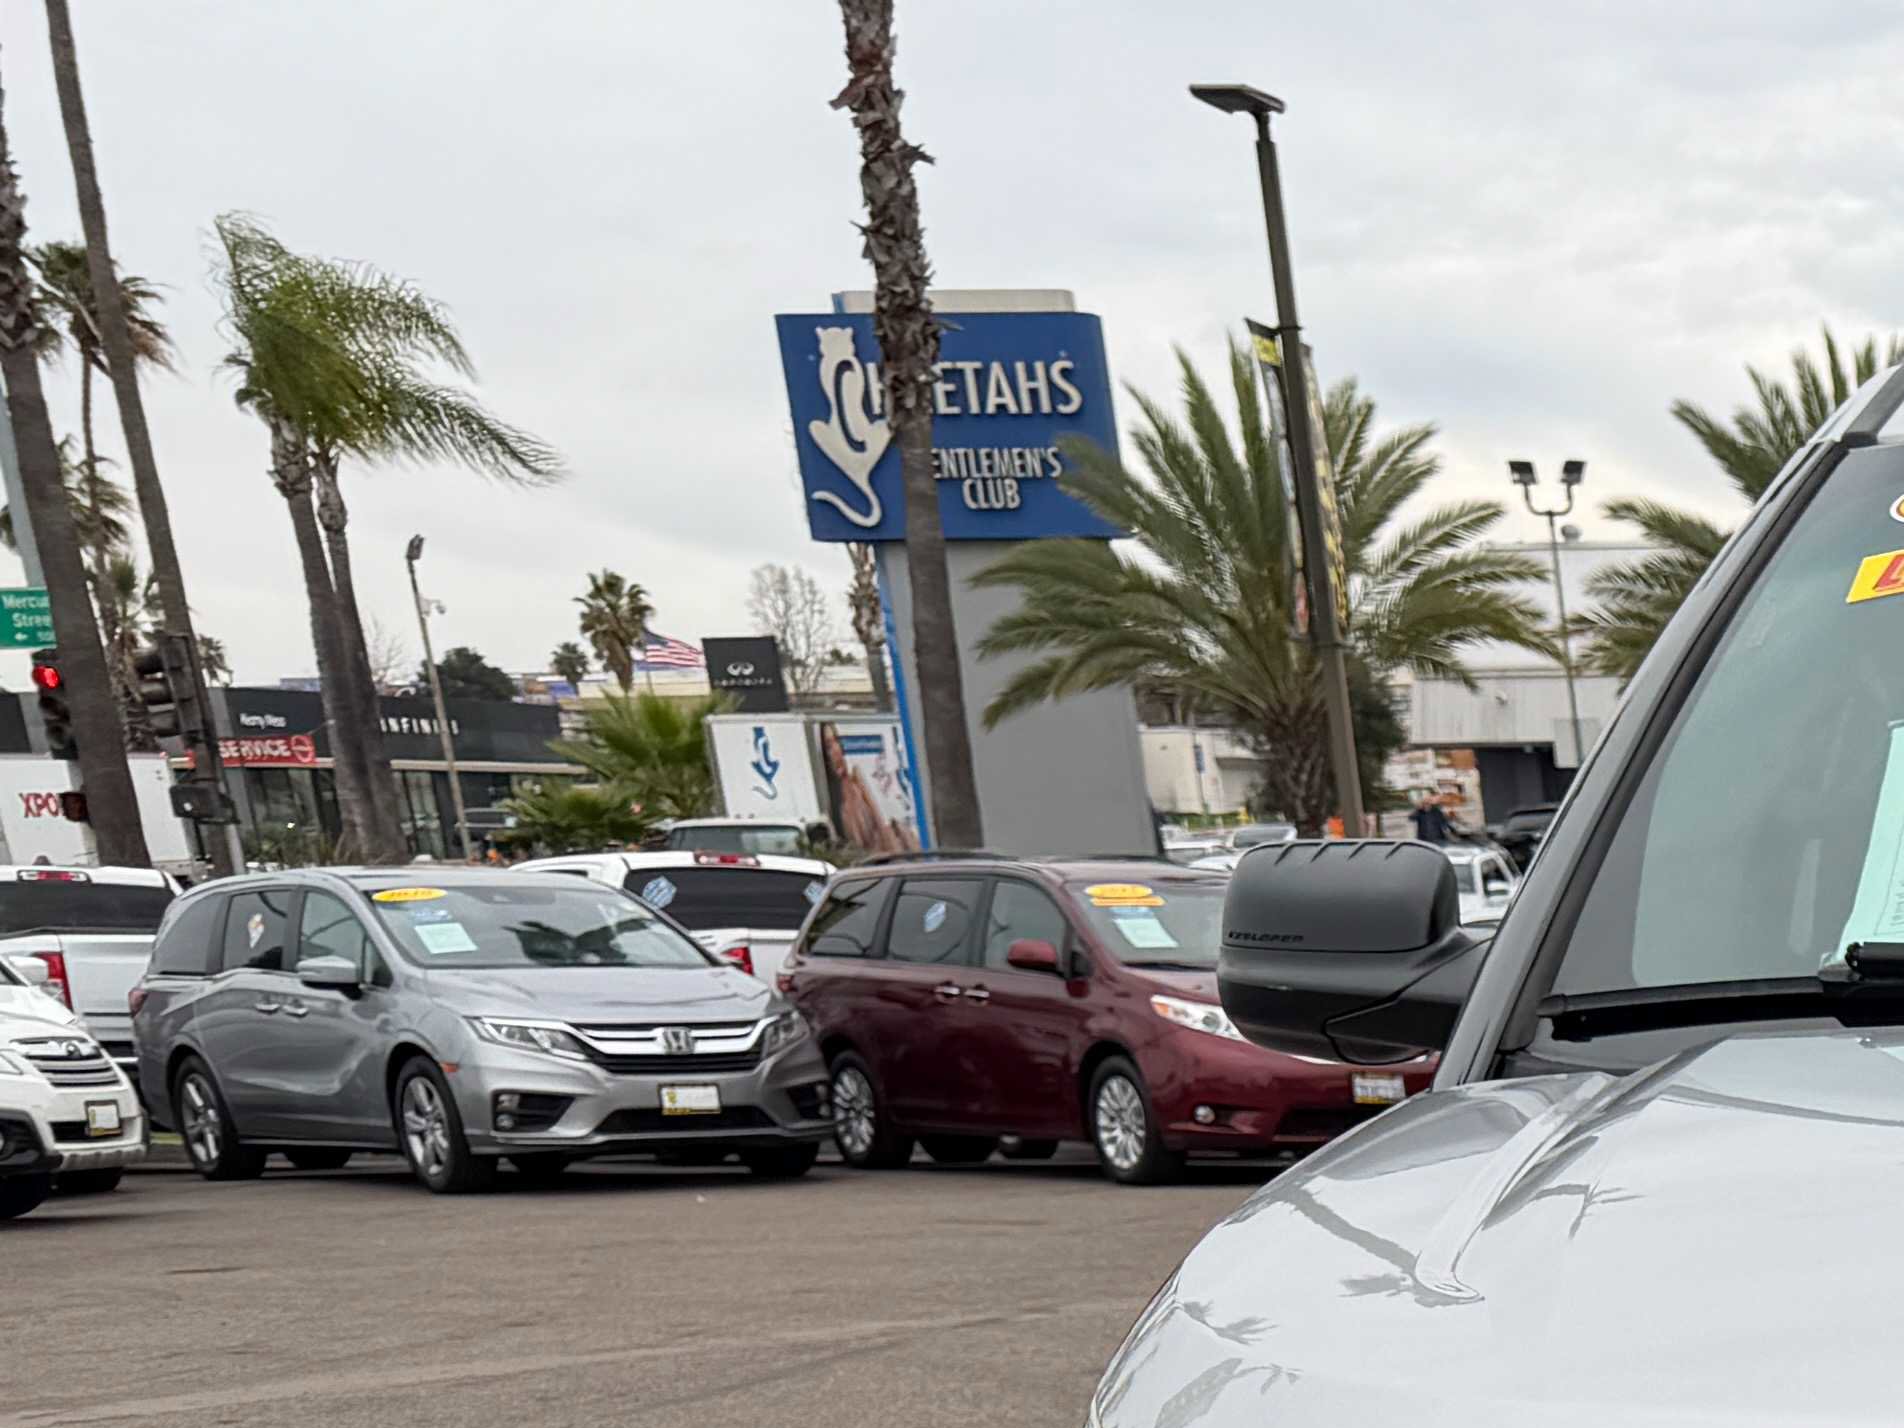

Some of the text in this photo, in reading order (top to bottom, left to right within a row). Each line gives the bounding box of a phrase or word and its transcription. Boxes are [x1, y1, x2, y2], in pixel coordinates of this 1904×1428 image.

[931, 446, 1063, 480] ENTLEMEN'S
[962, 477, 1022, 510] CLUB
[379, 716, 459, 735] INFINII
[219, 739, 292, 758] SERVICE
[18, 792, 59, 818] XPO
